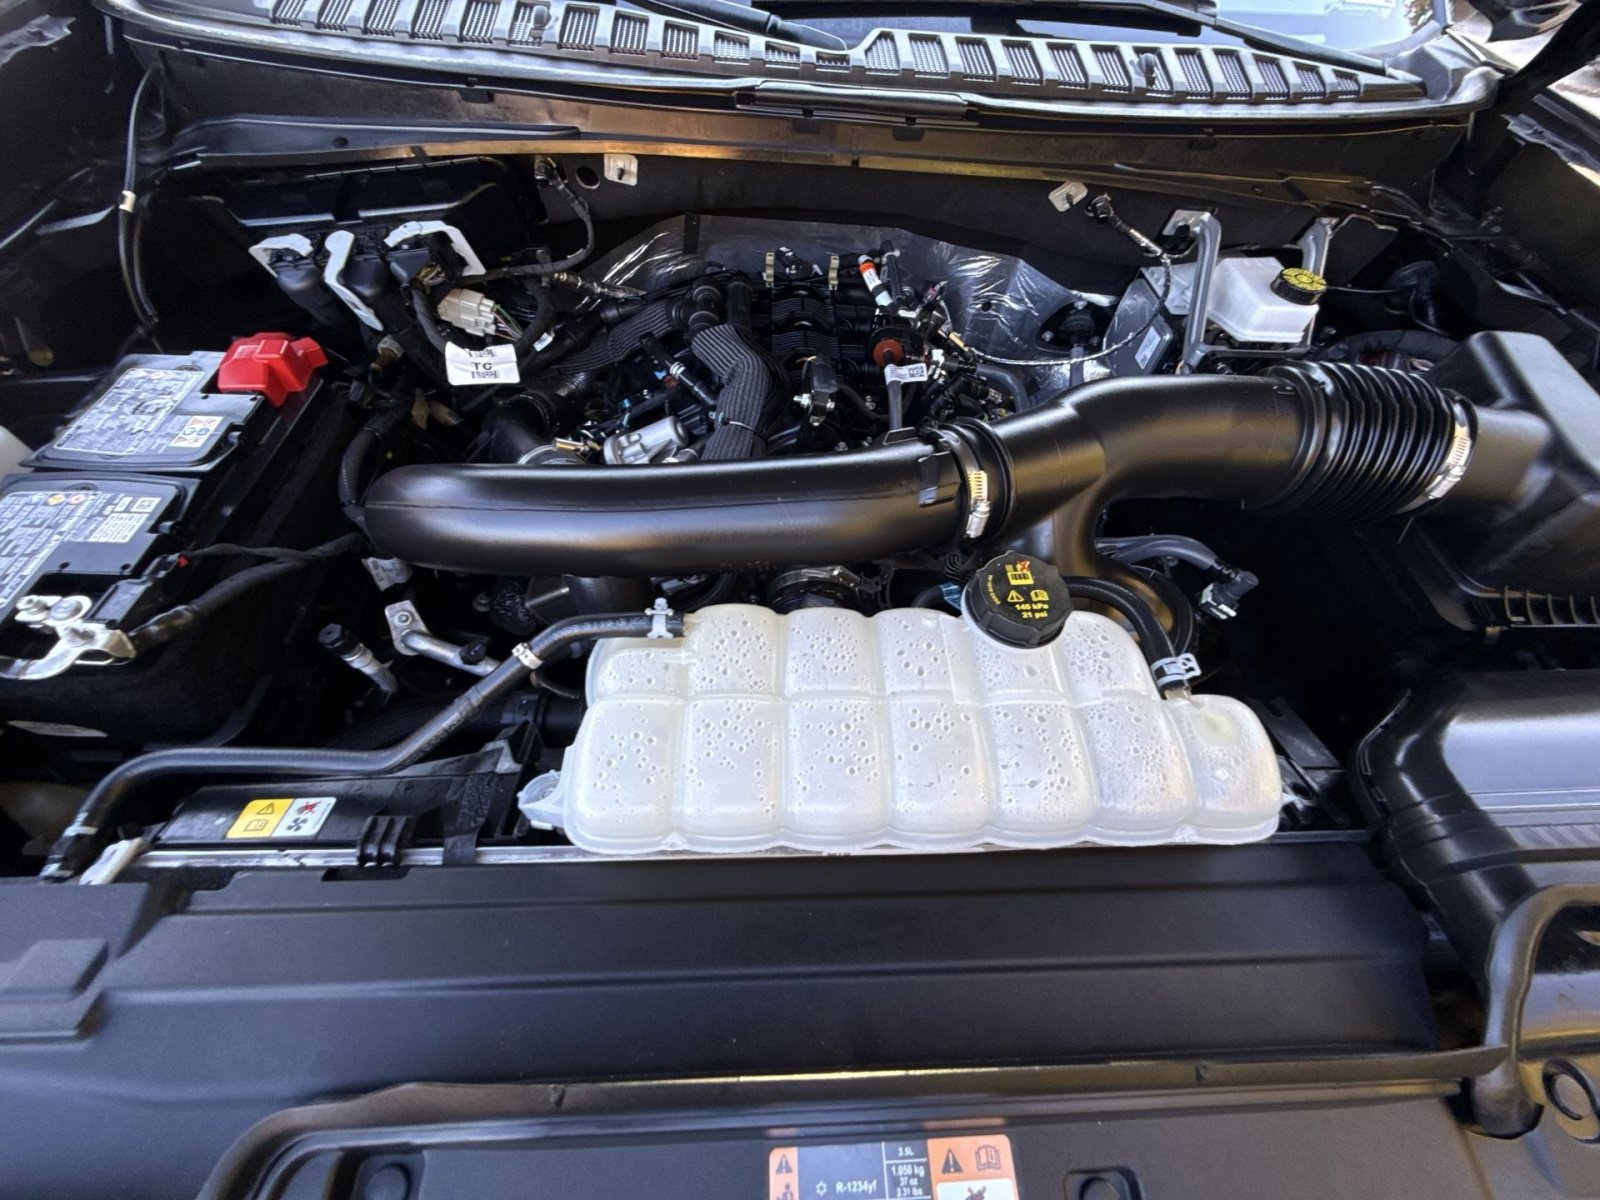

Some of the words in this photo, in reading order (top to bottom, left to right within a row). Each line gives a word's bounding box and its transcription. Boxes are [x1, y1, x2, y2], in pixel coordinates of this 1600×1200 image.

[471, 362, 492, 371] TC
[1021, 611, 1032, 619] 21
[1034, 611, 1048, 619] psi
[898, 1146, 914, 1156] 3.5L
[914, 1164, 925, 1177] kg
[900, 1177, 908, 1186] 37
[835, 1179, 877, 1194] R-1234yf
